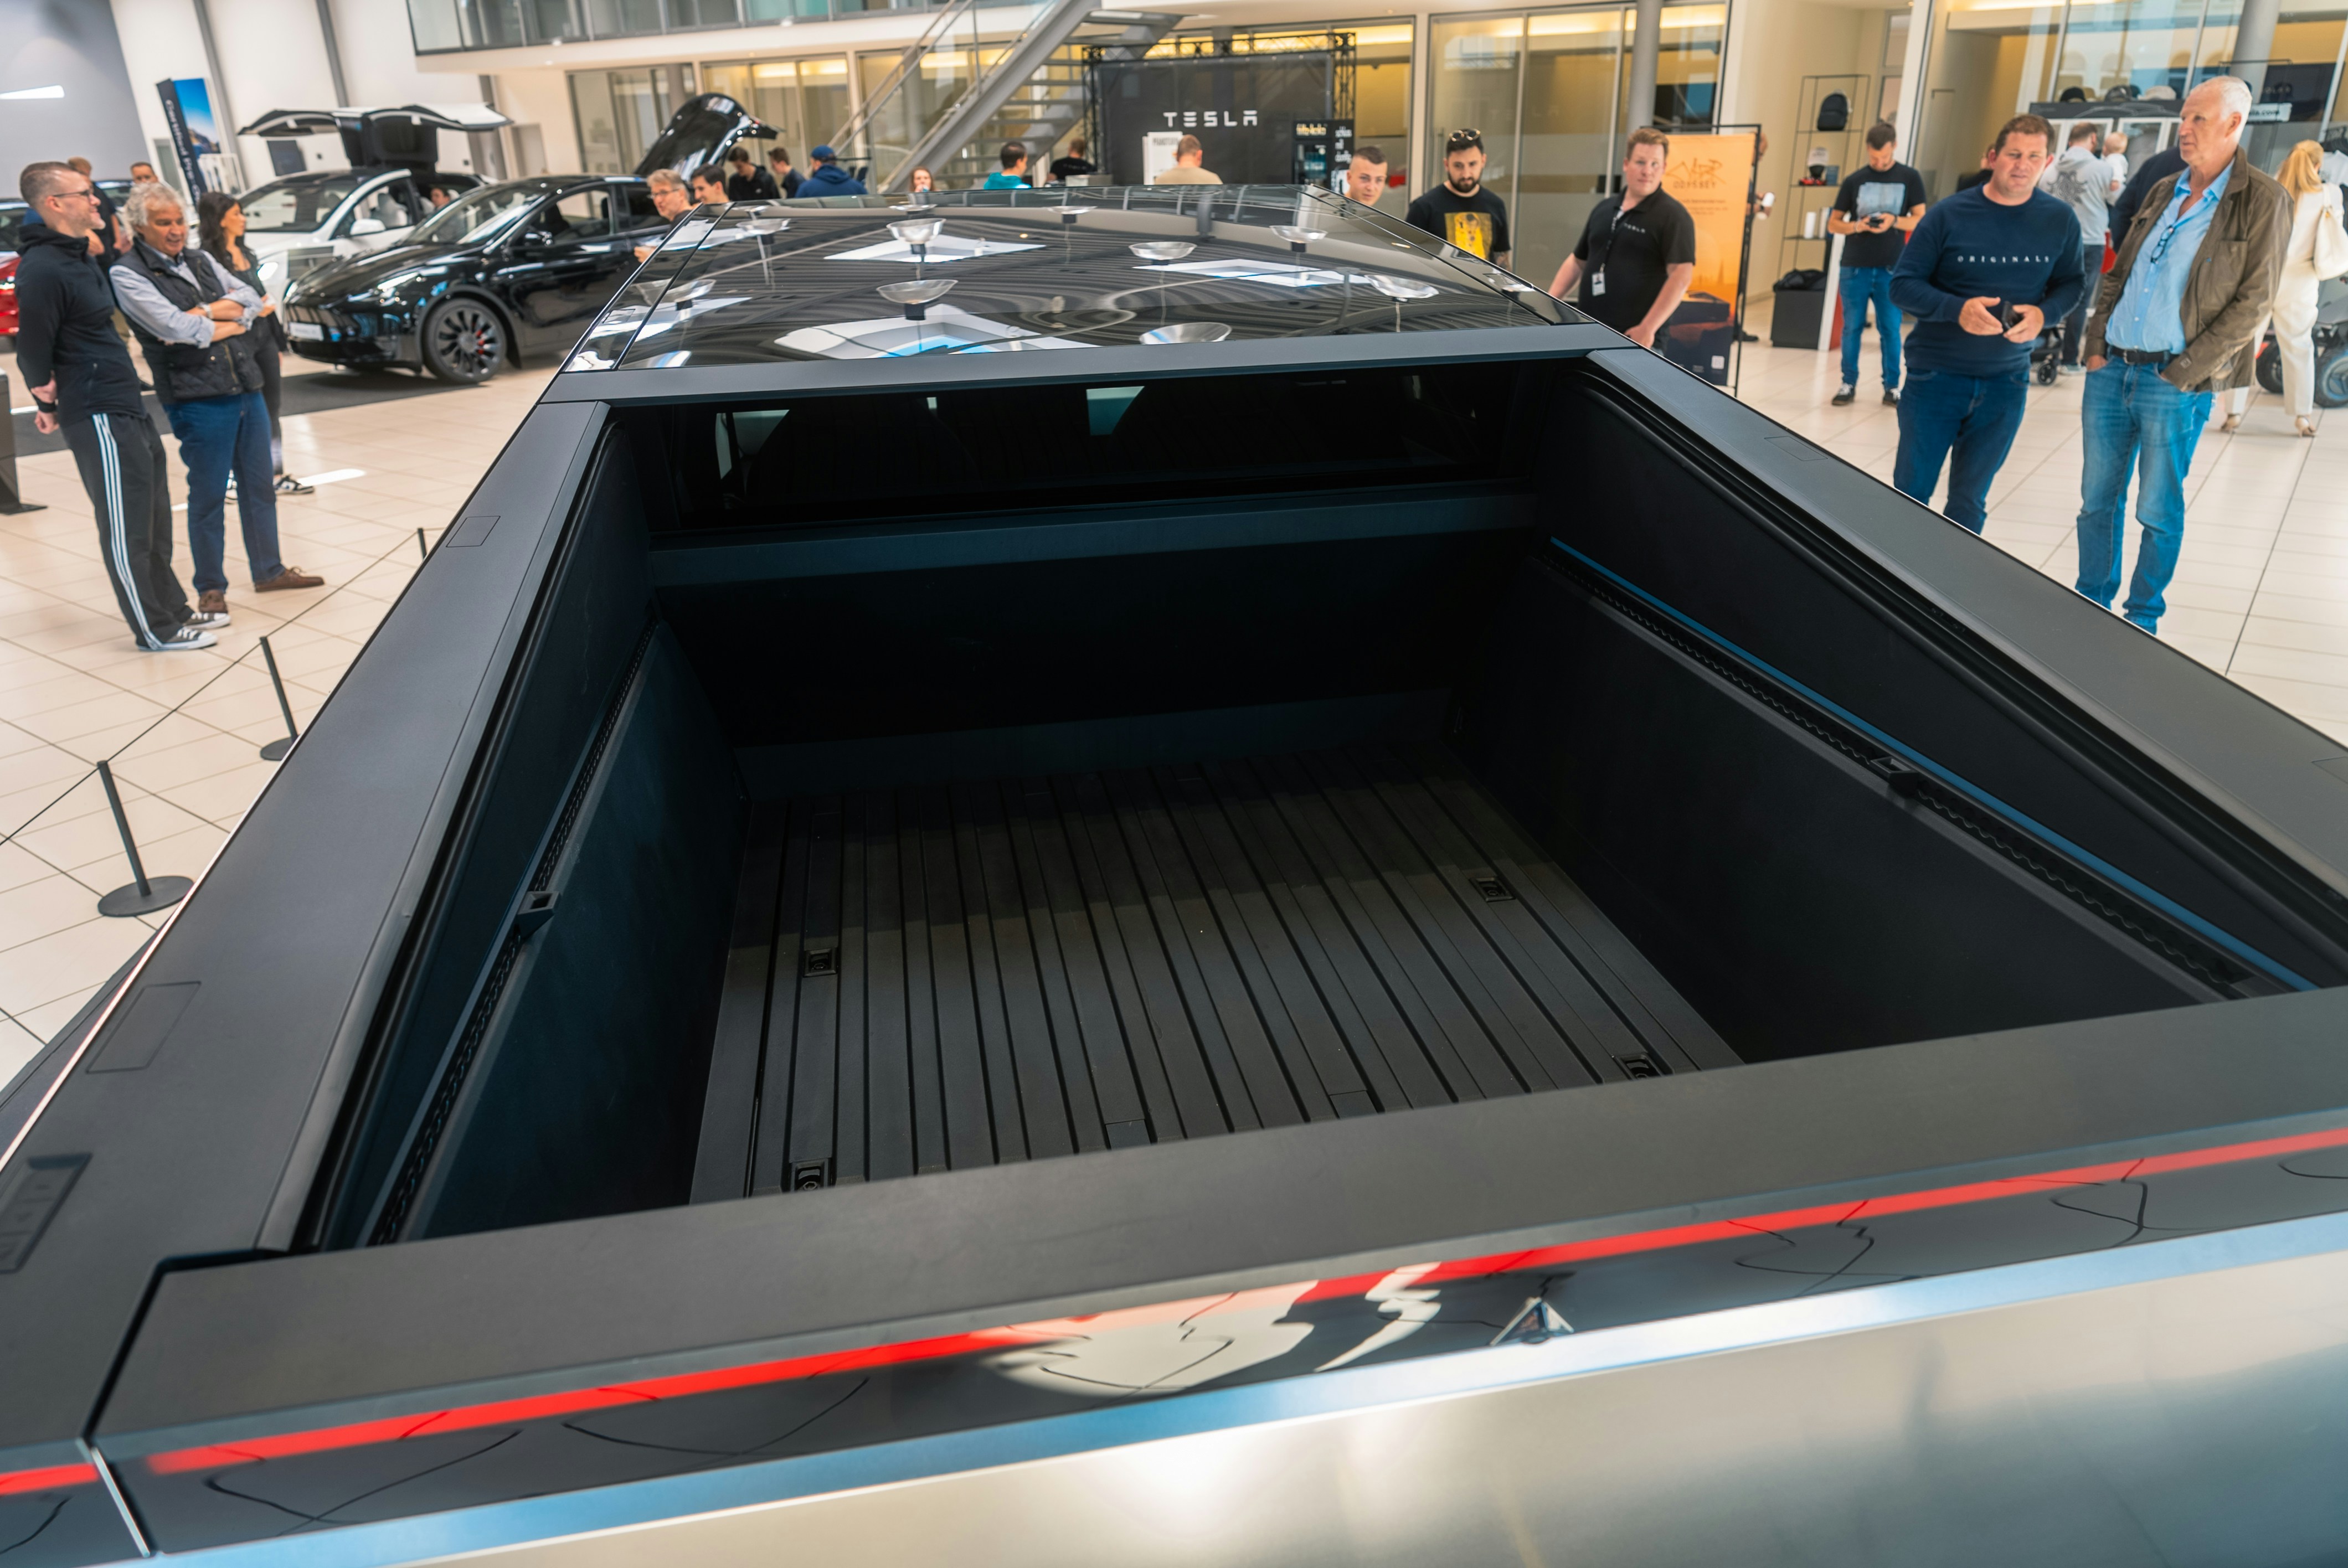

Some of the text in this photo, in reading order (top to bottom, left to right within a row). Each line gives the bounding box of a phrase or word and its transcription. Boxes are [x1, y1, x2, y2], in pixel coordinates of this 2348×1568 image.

[166, 99, 188, 155] Certified
[1163, 110, 1258, 128] TESLA
[1957, 255, 2050, 264] ORIGINALS
